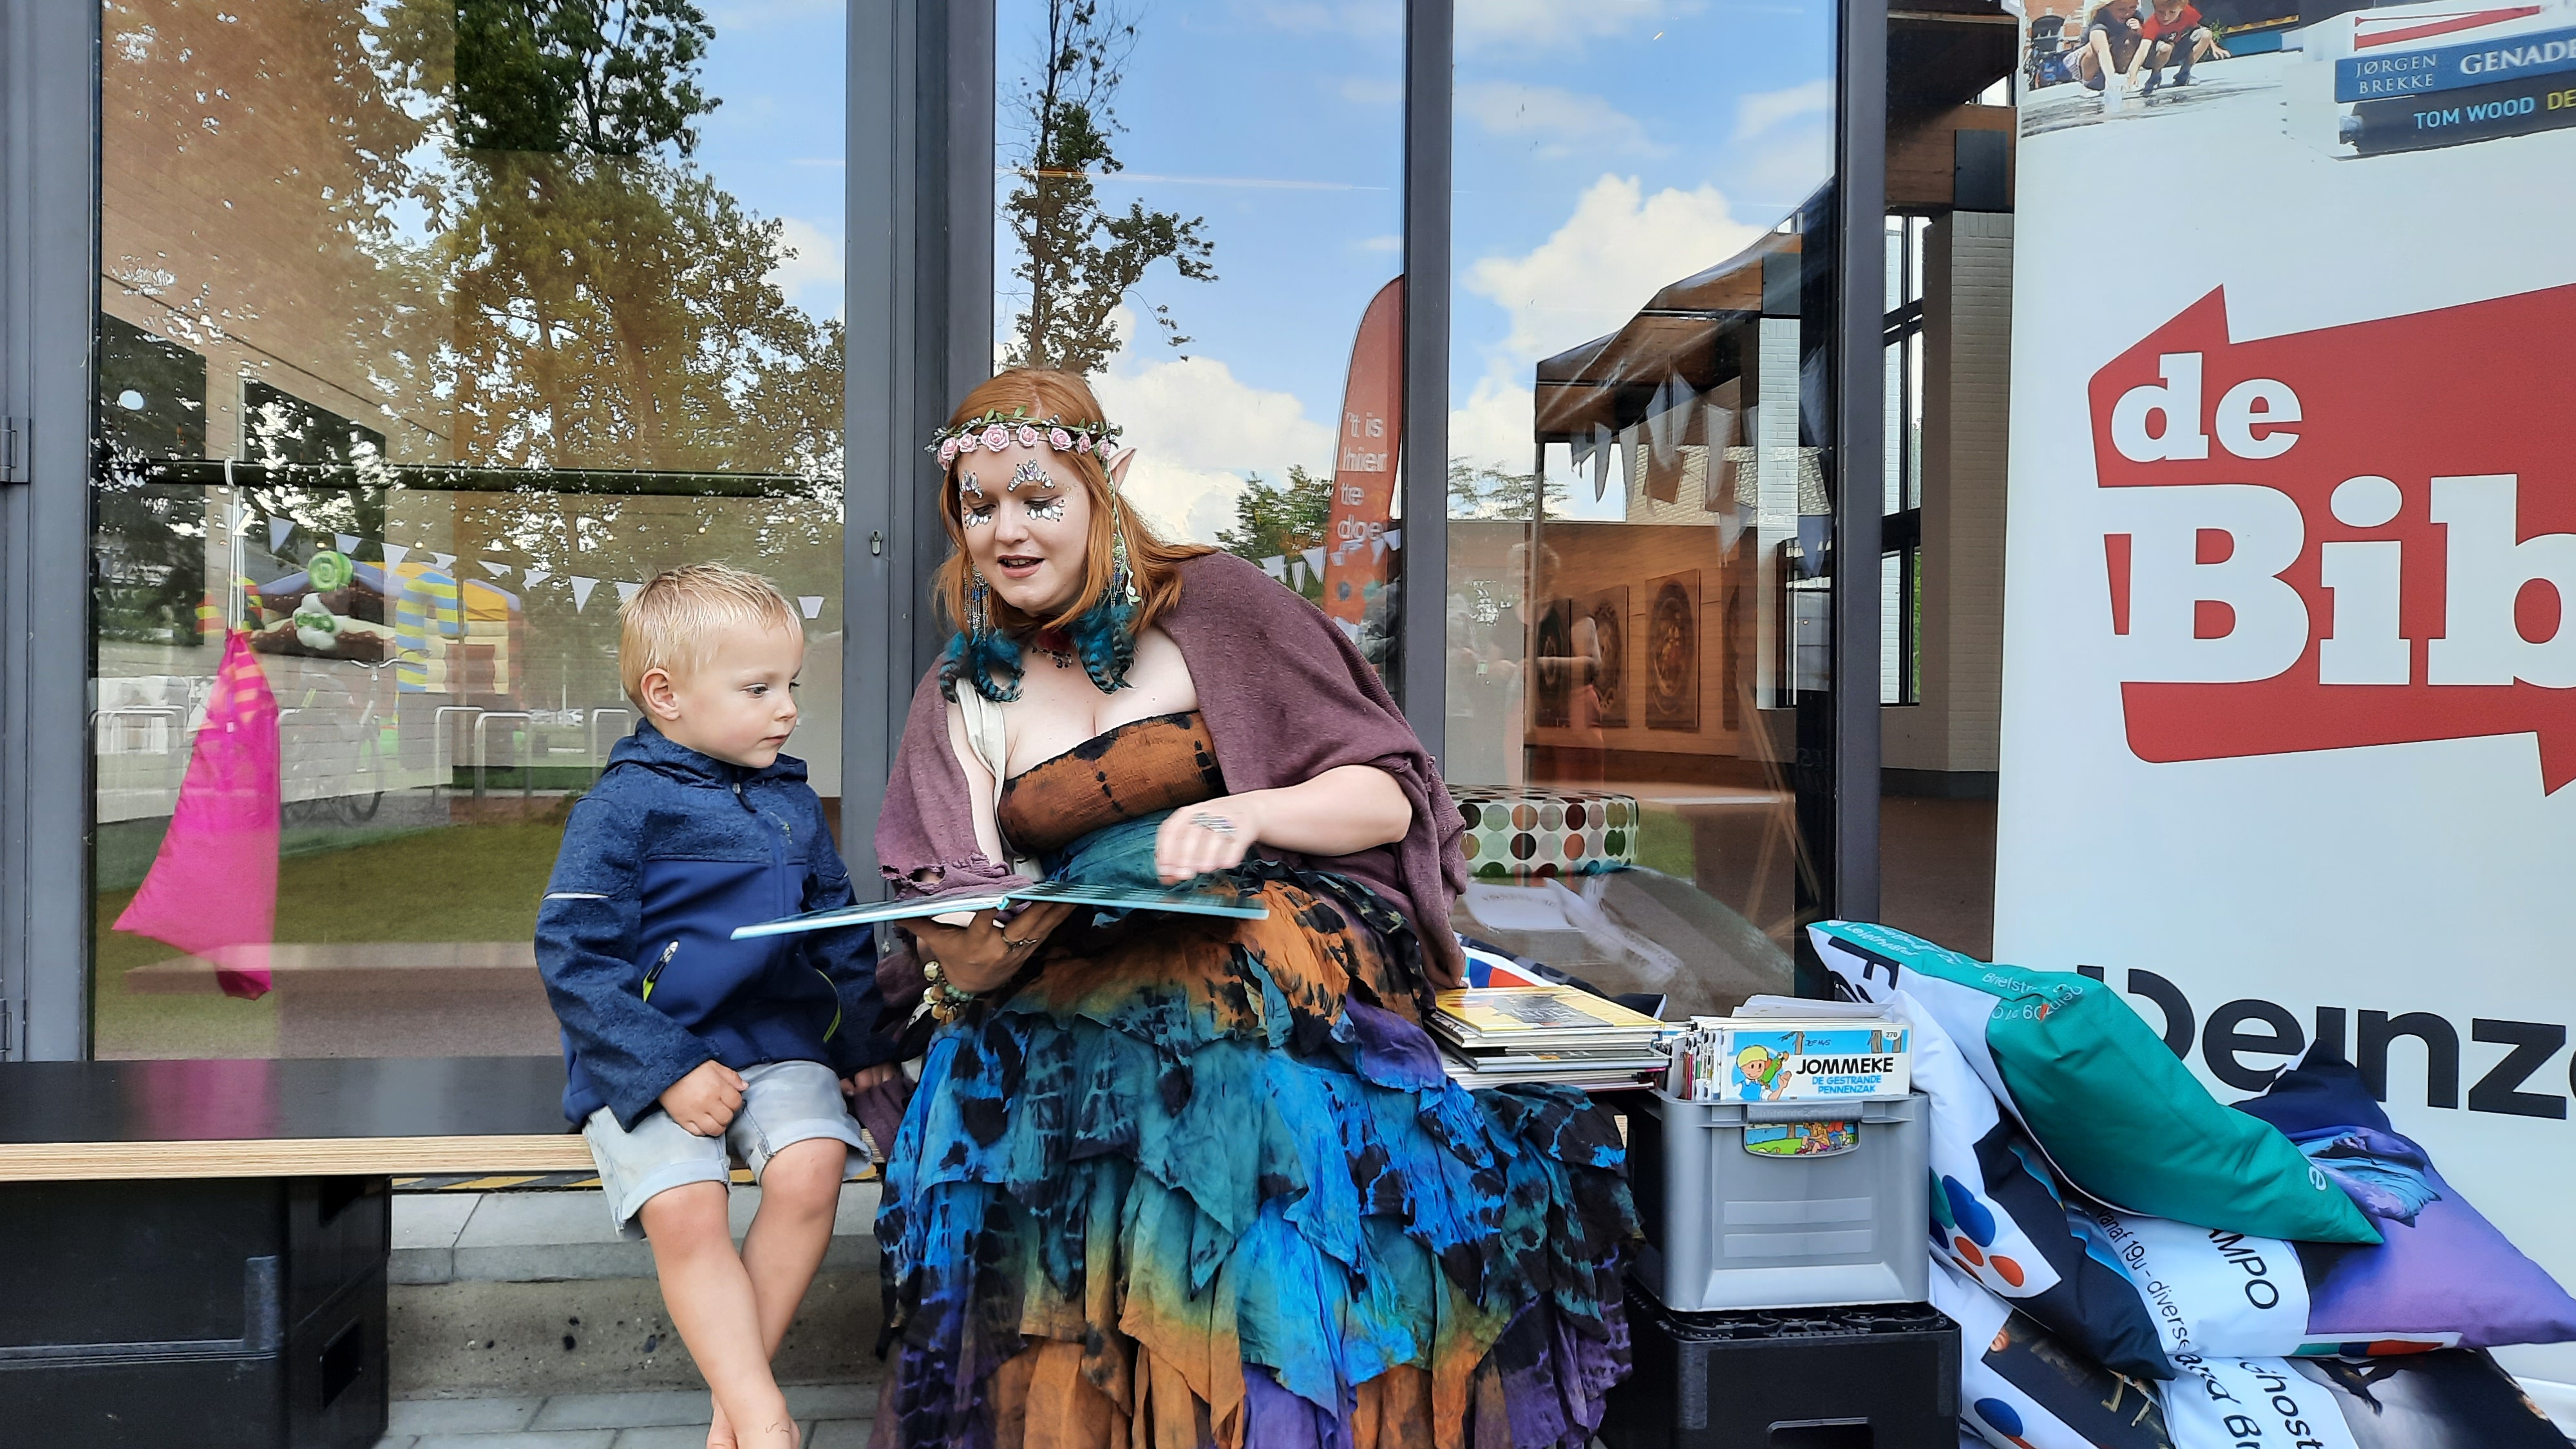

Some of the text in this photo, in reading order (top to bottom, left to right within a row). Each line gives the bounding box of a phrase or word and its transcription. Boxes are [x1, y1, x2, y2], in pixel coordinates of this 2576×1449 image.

[2355, 54, 2437, 78] JØRGEN
[2359, 73, 2434, 95] BREKKE
[2414, 107, 2460, 129] TOM
[2467, 97, 2535, 122] WOOD
[2110, 351, 2304, 463] de
[1365, 412, 1384, 439] is
[1342, 446, 1389, 472] hier
[1340, 482, 1364, 506] te
[1337, 515, 1386, 541] doe
[2112, 473, 2576, 690] Bib
[2077, 965, 2576, 1120] Deinz
[1795, 1057, 1894, 1075] JOMMEKE
[1818, 1085, 1875, 1094] PENNENZAK
[1826, 1075, 1882, 1084] GESTRANDE
[2096, 1207, 2134, 1244] vanaf
[2122, 1240, 2148, 1271] 19u
[2208, 1227, 2279, 1309] MPO
[2174, 1353, 2242, 1405] and
